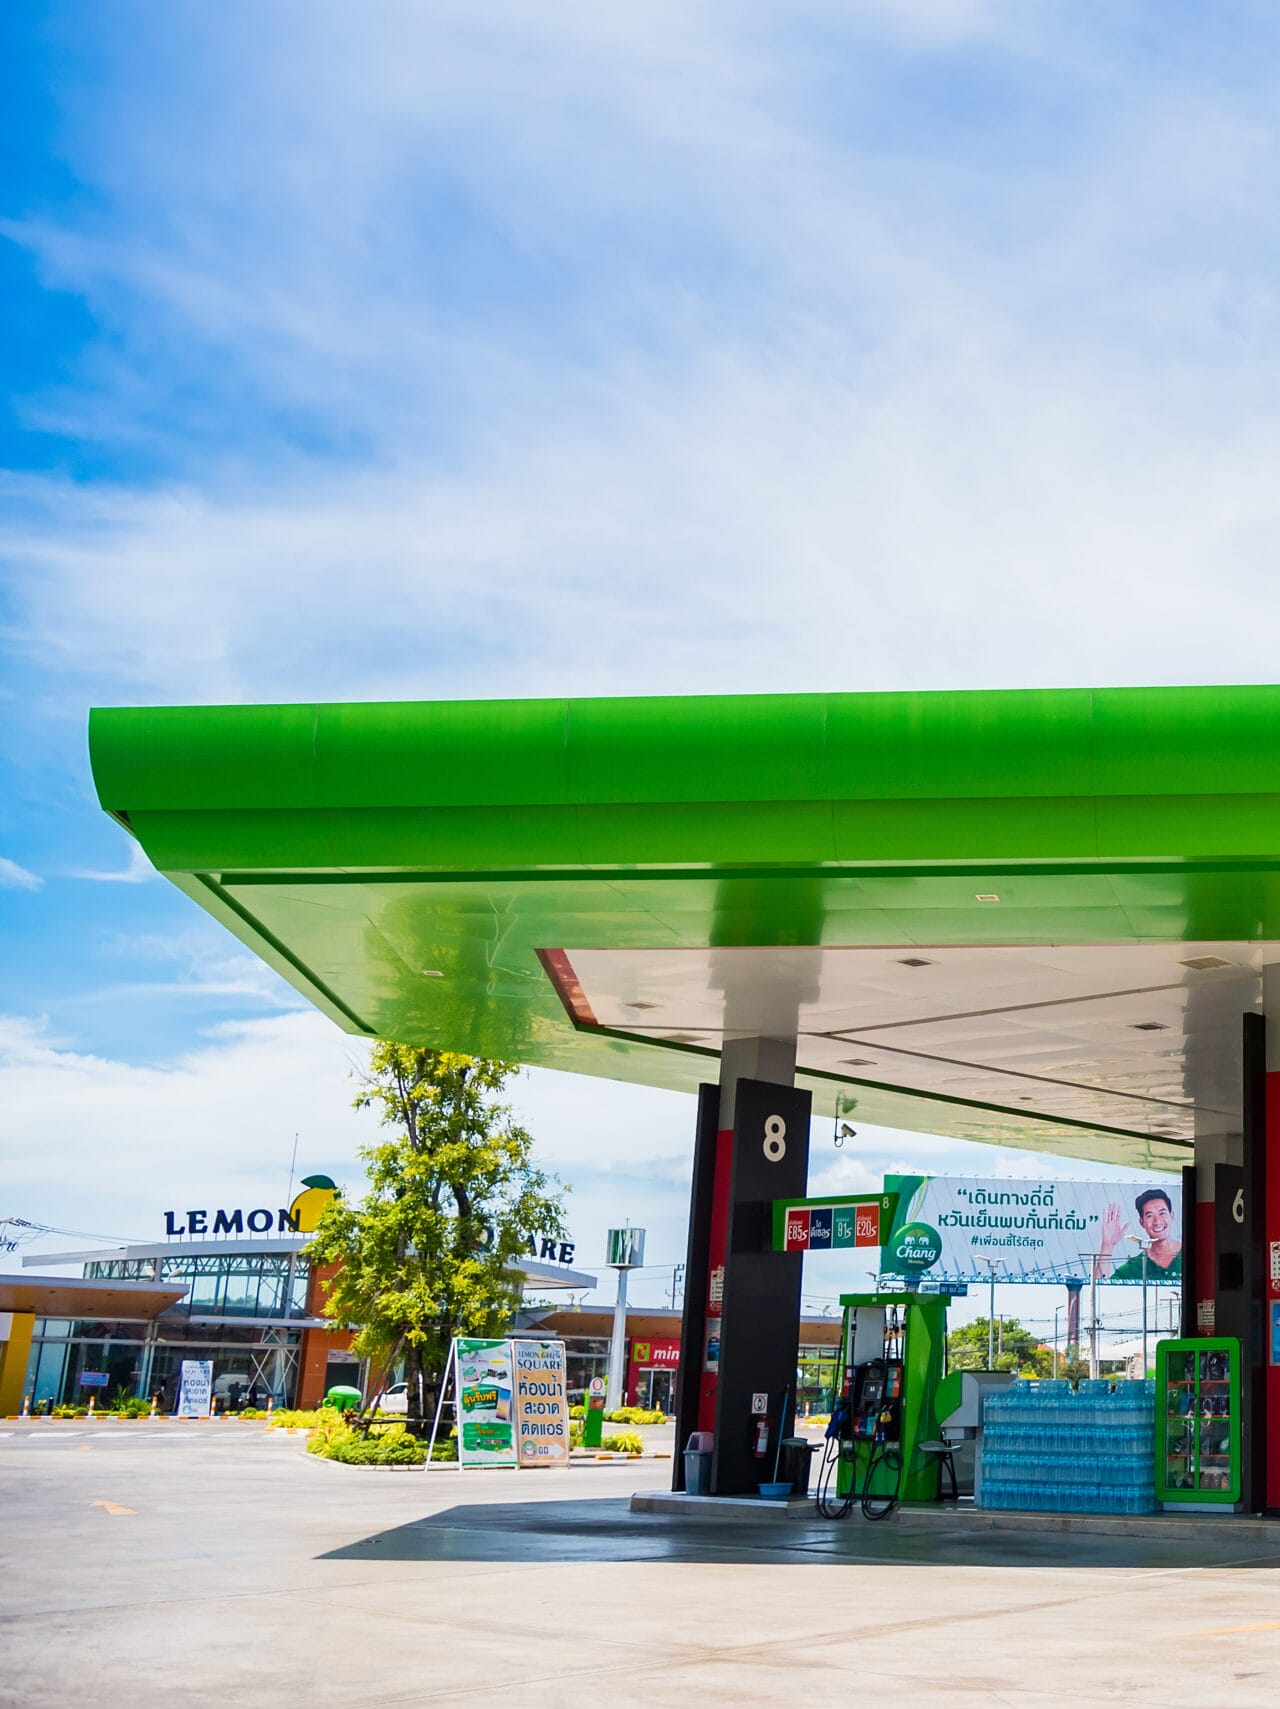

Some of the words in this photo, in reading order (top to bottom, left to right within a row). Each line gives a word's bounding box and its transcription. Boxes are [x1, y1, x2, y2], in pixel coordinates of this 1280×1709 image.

[763, 1114, 786, 1162] 8
[882, 1196, 890, 1209] 8
[1232, 1188, 1244, 1224] 6
[164, 1209, 301, 1235] LEMON
[896, 1245, 937, 1261] Chang
[517, 1359, 562, 1370] SQUARE
[519, 1375, 563, 1396] ห้องน้ำ
[524, 1402, 560, 1414] สะอาด
